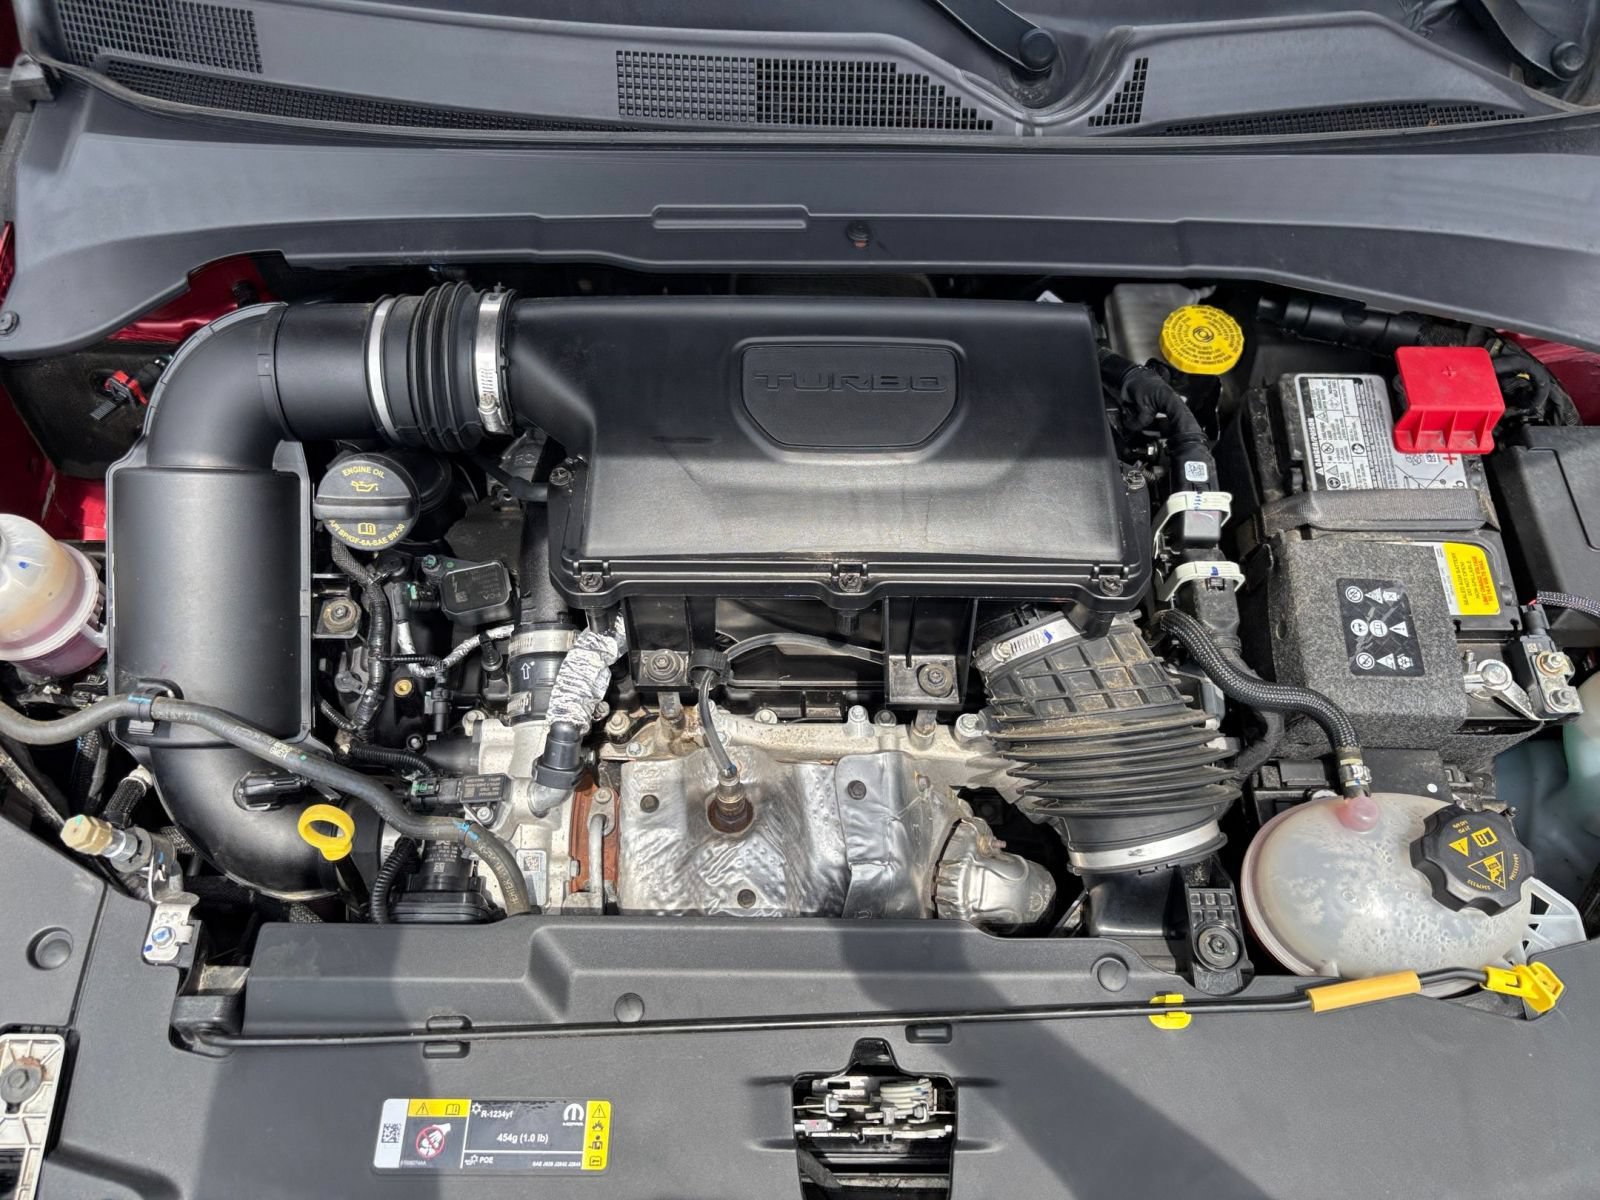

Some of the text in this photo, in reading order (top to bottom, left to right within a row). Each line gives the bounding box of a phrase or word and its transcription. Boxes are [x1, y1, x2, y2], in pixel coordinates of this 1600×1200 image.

[753, 372, 947, 392] TURBO
[1307, 417, 1321, 466] DANGER/POISON
[342, 466, 385, 479] ENGINE OIL
[480, 1110, 514, 1120] R-1234yf
[497, 1133, 549, 1144] 454g (1.0 lb)
[479, 1156, 494, 1164] POE
